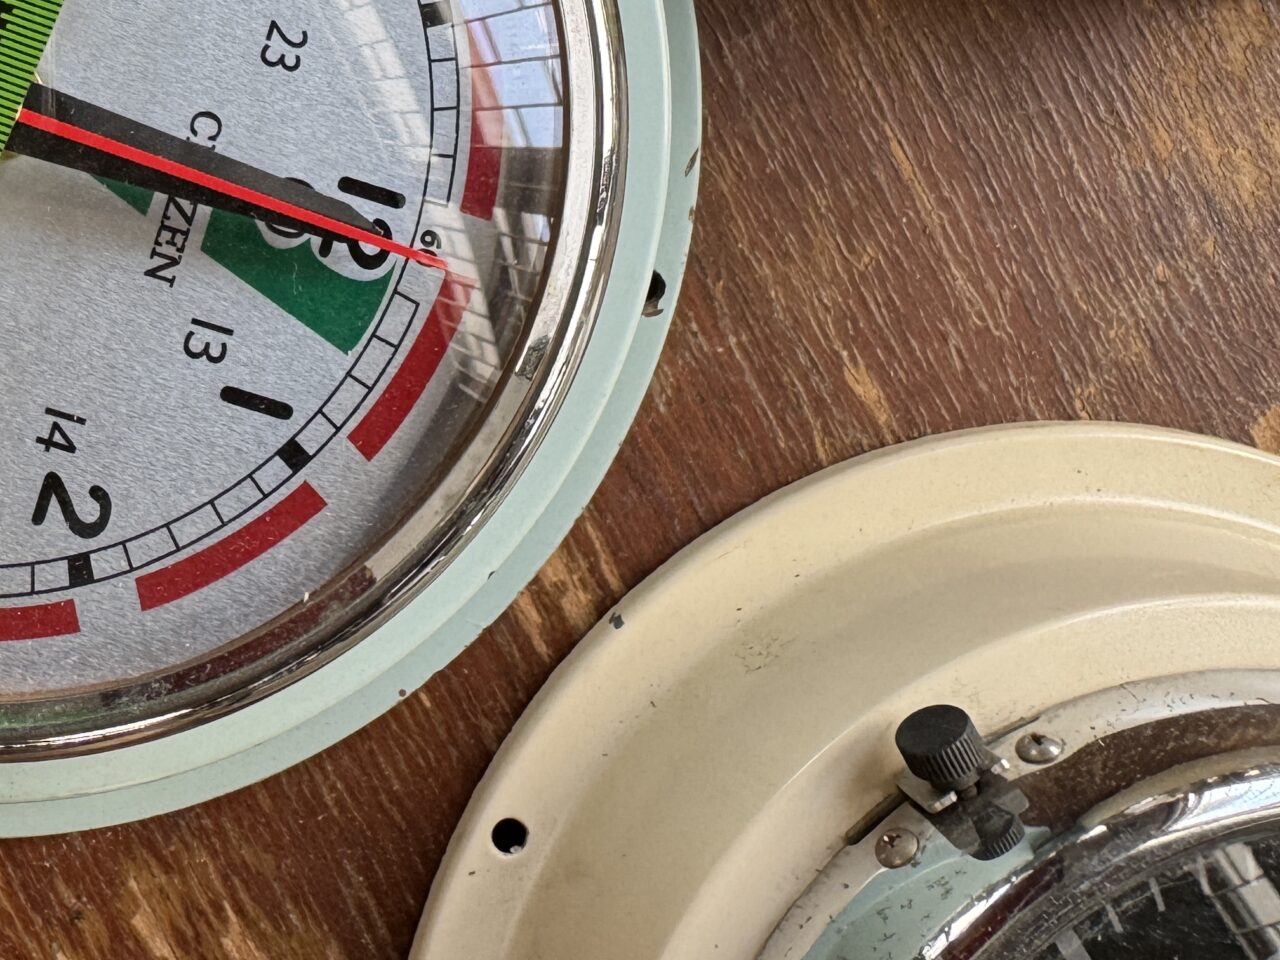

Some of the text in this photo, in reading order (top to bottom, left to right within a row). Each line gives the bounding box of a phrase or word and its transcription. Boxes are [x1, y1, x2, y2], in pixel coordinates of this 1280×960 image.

[260, 20, 308, 73] 23
[143, 111, 223, 288] CZEN
[183, 317, 234, 364] 13
[220, 385, 294, 420] 1
[35, 407, 86, 454] 14
[31, 471, 112, 539] 2
